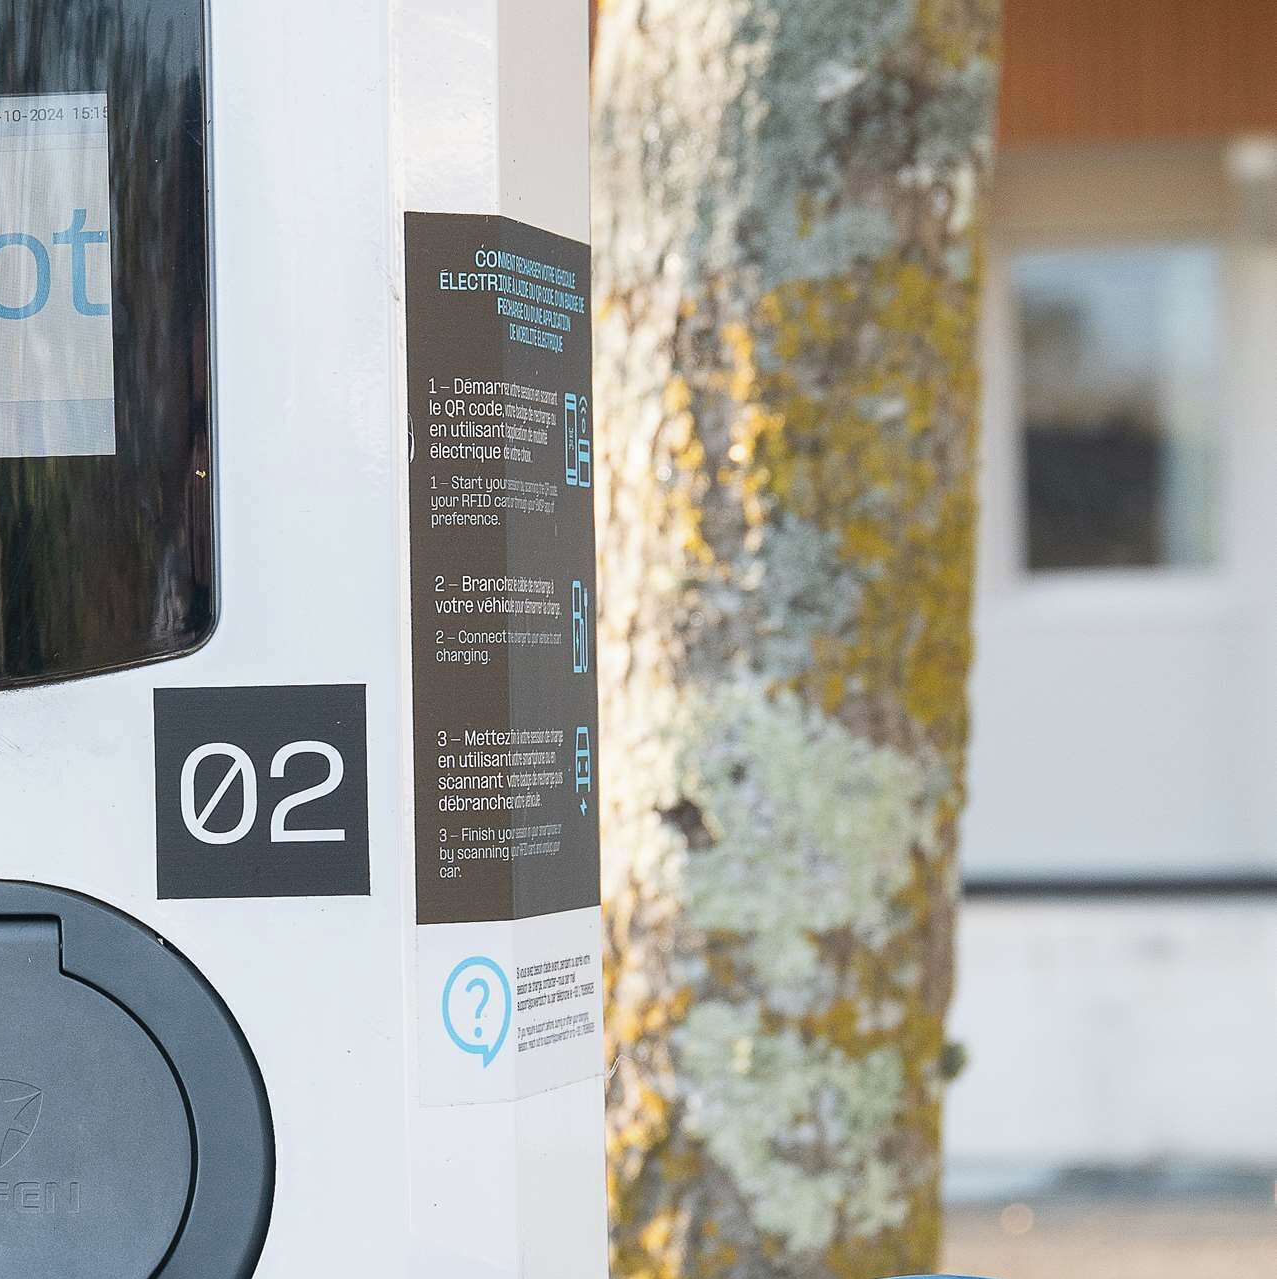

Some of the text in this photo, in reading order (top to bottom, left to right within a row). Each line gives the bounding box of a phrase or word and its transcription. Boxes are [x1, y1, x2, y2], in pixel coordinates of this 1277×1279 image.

[428, 378, 437, 394] 1
[429, 400, 442, 416] le
[444, 401, 465, 417] QR
[468, 401, 505, 418] code,
[430, 424, 447, 438] en
[451, 422, 505, 438] utilisant
[430, 442, 502, 462] électrique
[430, 476, 438, 489] 1
[451, 475, 483, 489] Start
[431, 495, 459, 510] your
[461, 494, 491, 508] RFID
[431, 512, 501, 529] preference.
[434, 576, 445, 592] 2
[435, 598, 474, 614] votre
[435, 631, 444, 644] 2
[458, 630, 507, 645] Connect
[436, 648, 491, 664] charging.
[437, 730, 447, 747] 3
[465, 729, 510, 747] Mettez
[438, 754, 455, 769] en
[459, 751, 511, 768] utilisant
[438, 772, 503, 790] scannant
[180, 740, 345, 845] 02
[439, 828, 447, 842] 3
[462, 827, 495, 842] Finish
[440, 847, 454, 862] by
[457, 846, 509, 862] scanning
[440, 865, 462, 879] car.
